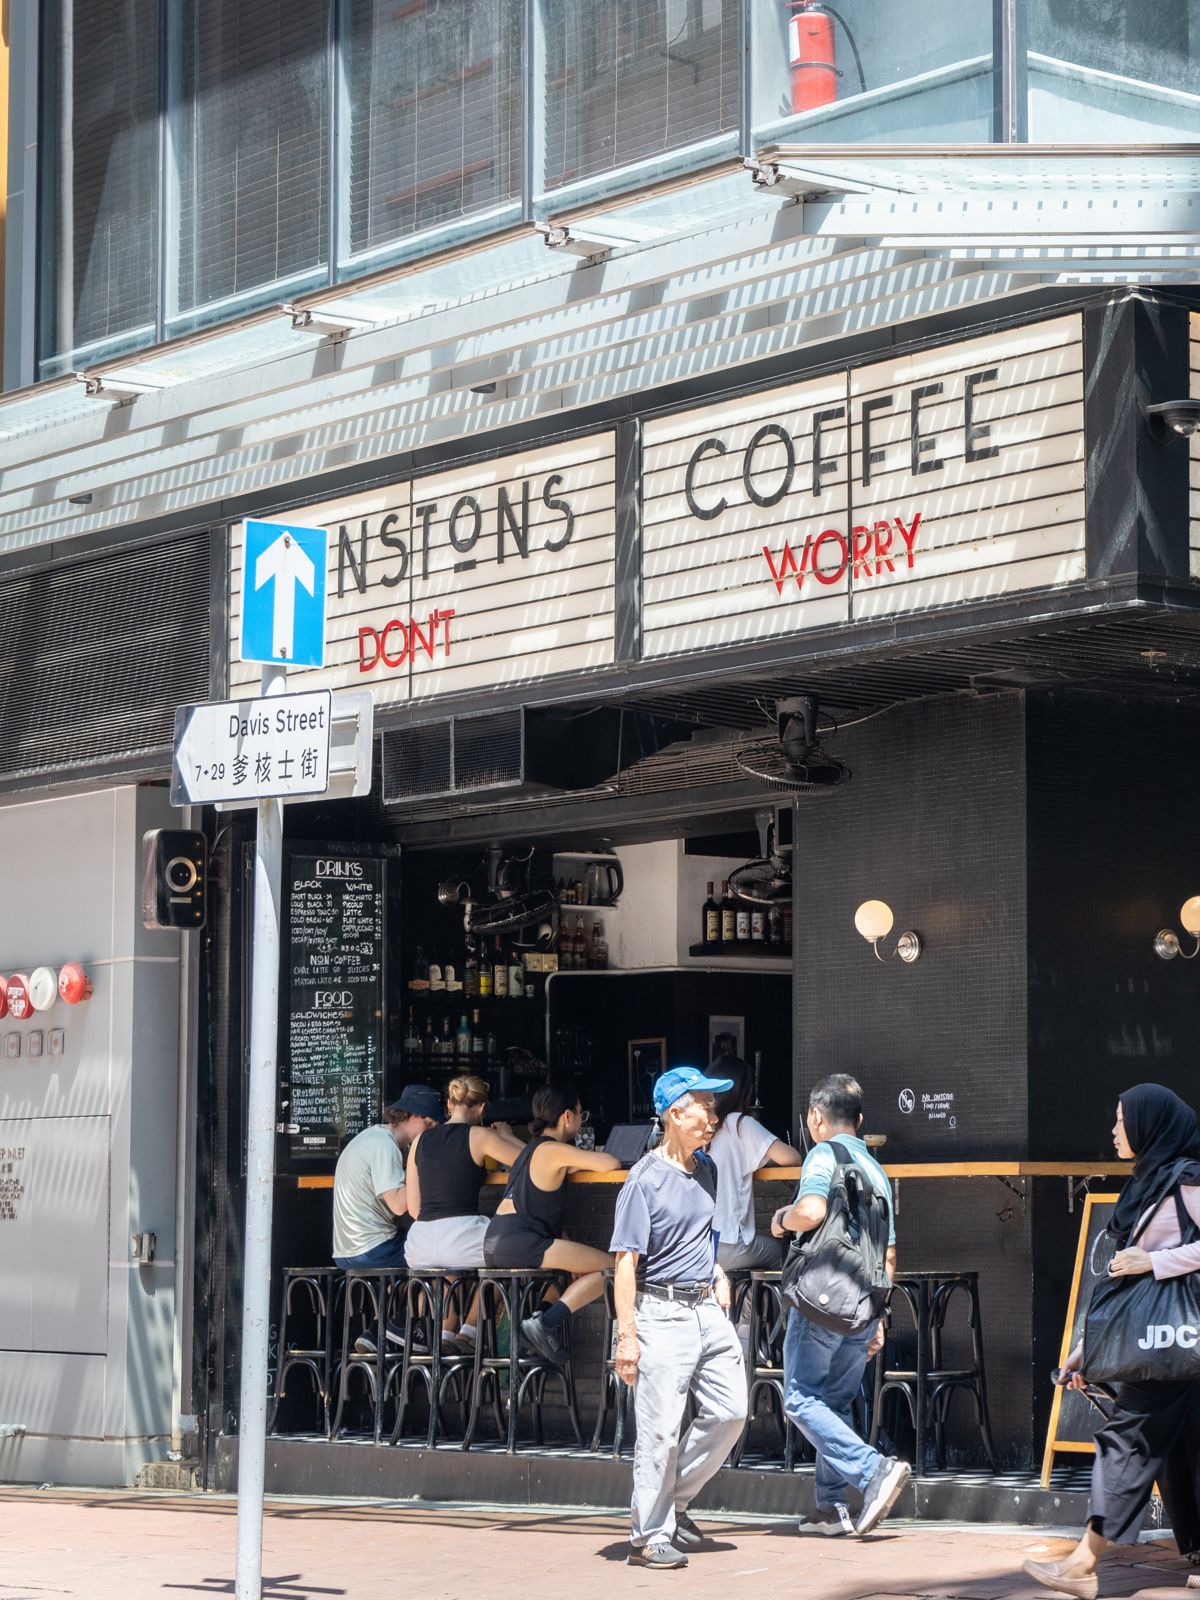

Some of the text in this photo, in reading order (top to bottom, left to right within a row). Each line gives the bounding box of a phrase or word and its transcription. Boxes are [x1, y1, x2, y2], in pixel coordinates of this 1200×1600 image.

[337, 368, 1000, 599] NSTONS COFFEE
[358, 512, 922, 672] DON'T WORRY
[229, 706, 325, 738] Davis Street
[232, 747, 319, 786] 爹核士街
[316, 860, 363, 876] DRINKS
[313, 966, 329, 974] LATTE
[347, 965, 370, 973] JUICES
[315, 991, 353, 1007] FOOD
[341, 1073, 375, 1086] SWEETS
[342, 1087, 369, 1095] MUFFINS
[1137, 1324, 1198, 1350] JDC
